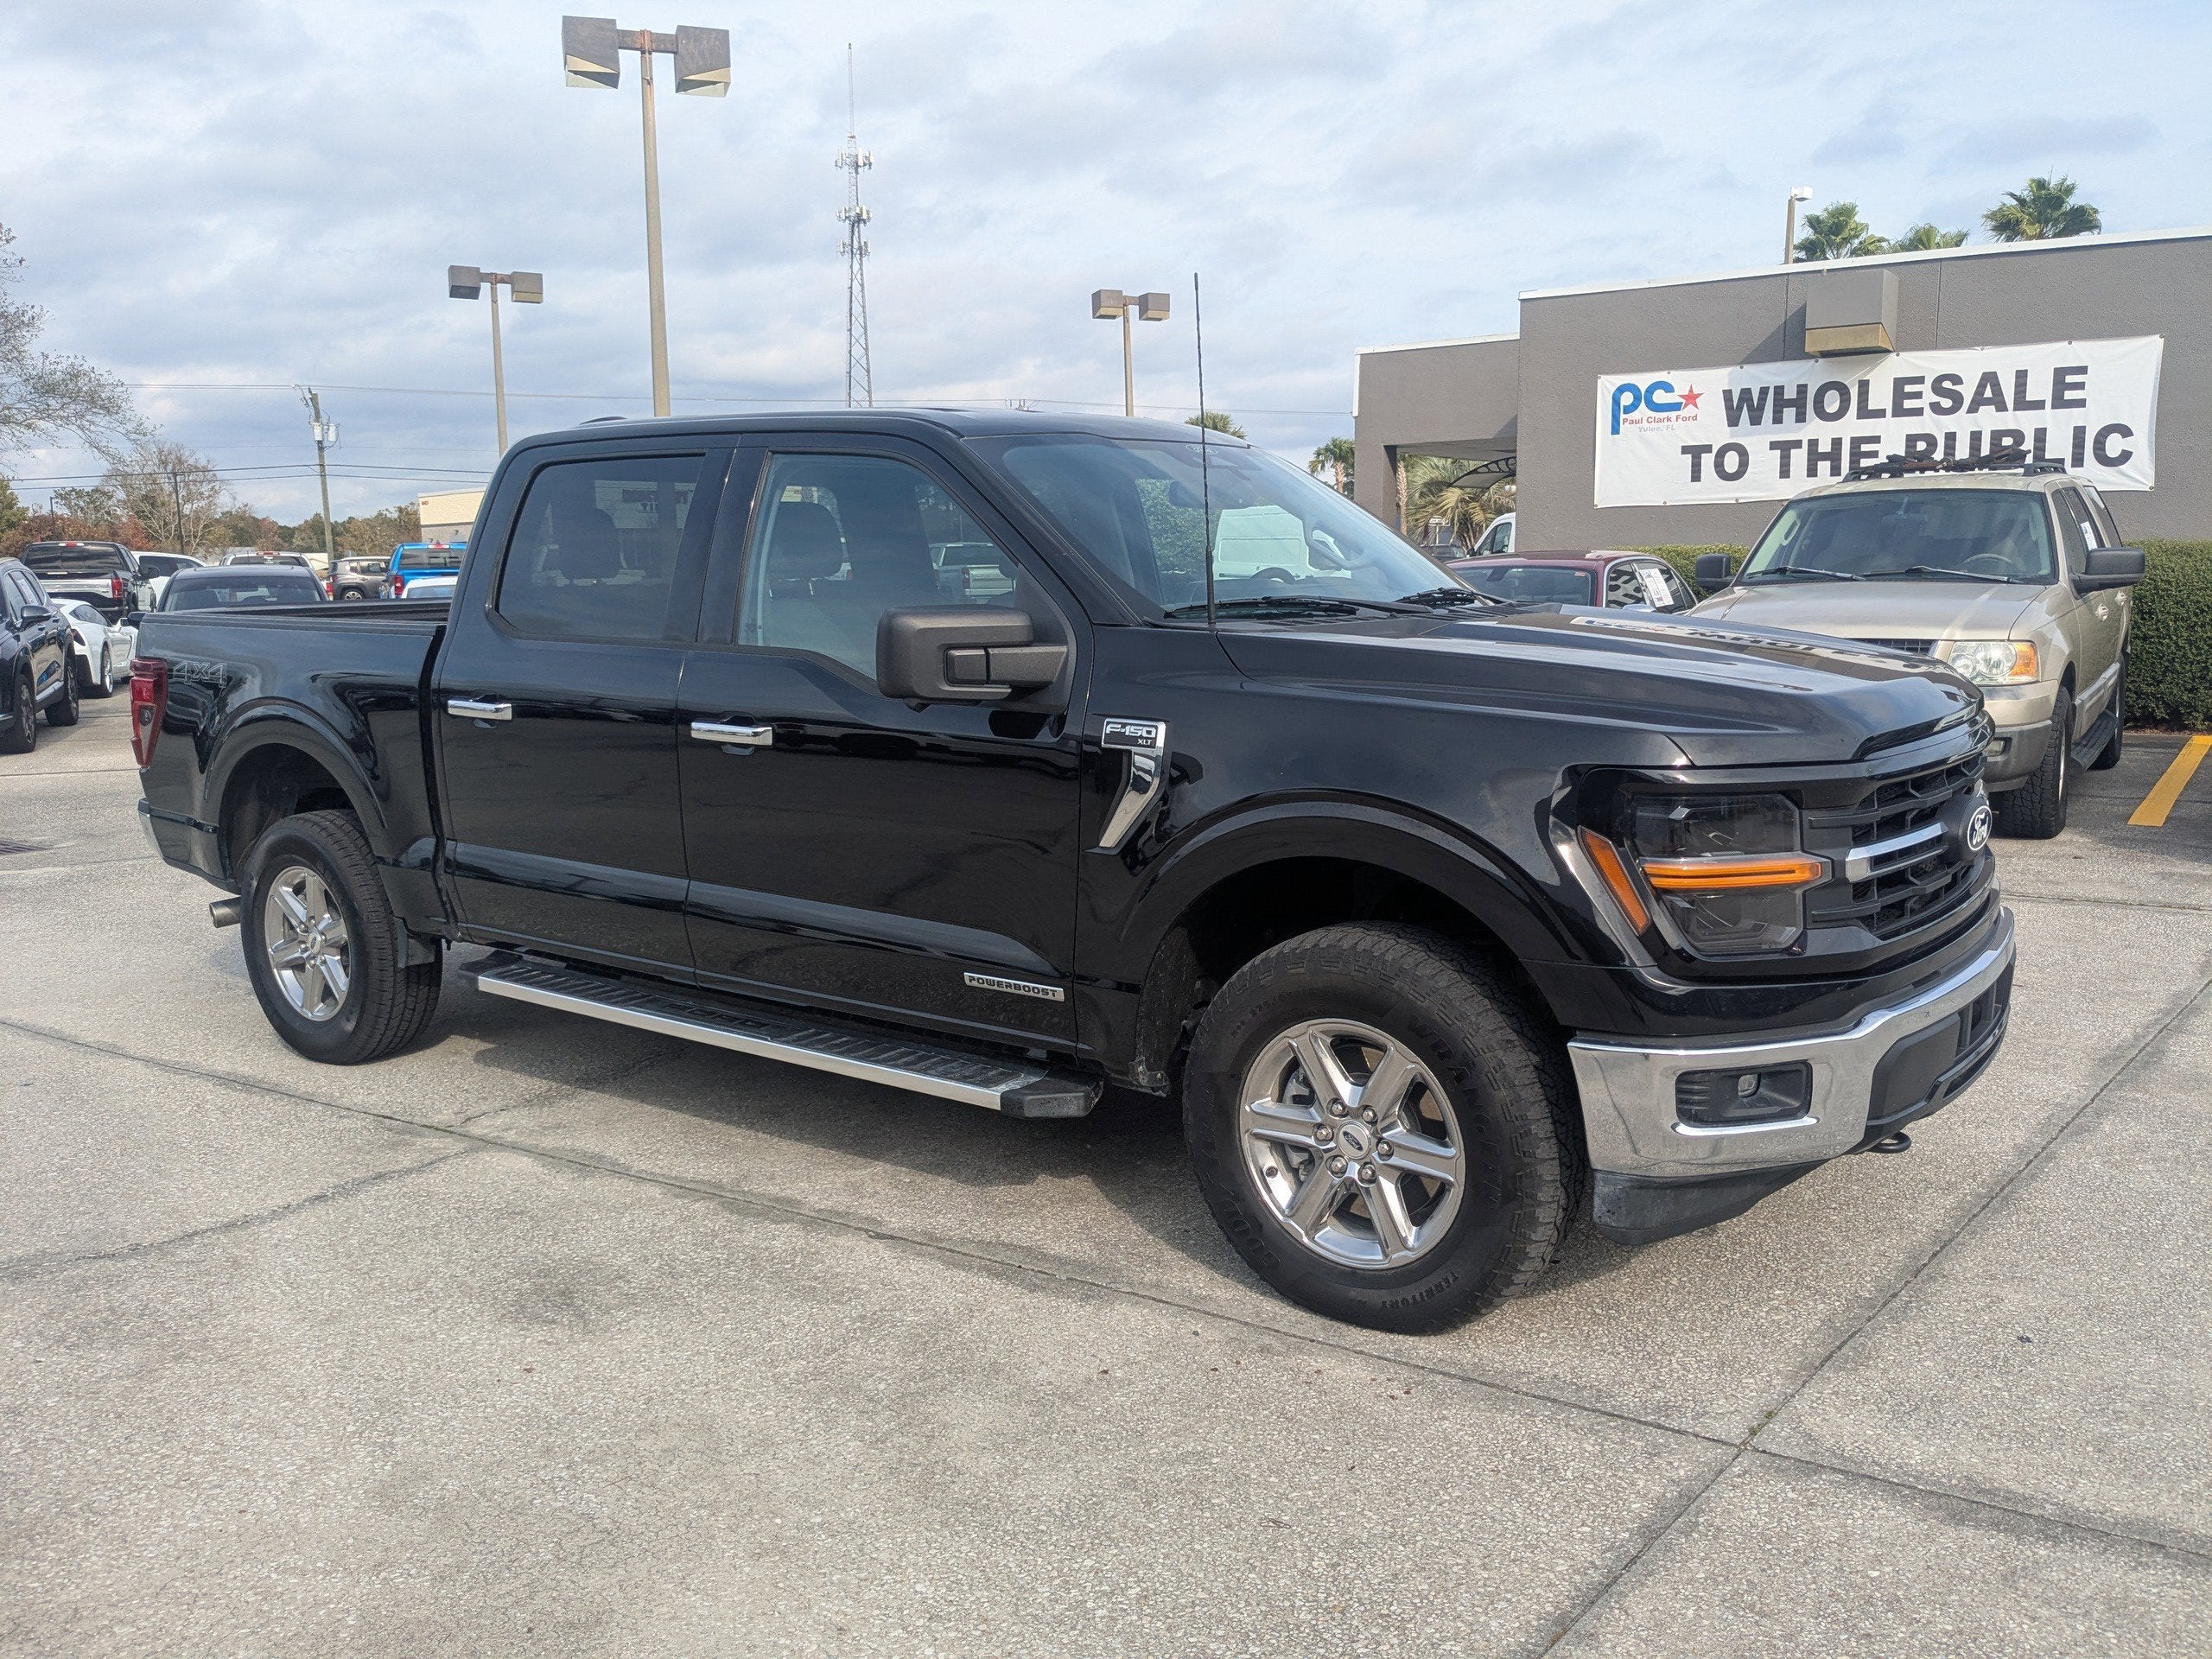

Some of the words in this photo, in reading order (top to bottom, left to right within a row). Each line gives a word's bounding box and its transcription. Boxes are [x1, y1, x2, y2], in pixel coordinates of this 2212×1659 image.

[1722, 365, 2089, 428] WHOLESALE
[1622, 416, 1643, 425] Paul
[1646, 415, 1673, 424] Clark
[1675, 413, 1698, 423] Ford
[1681, 442, 1750, 483] TO
[1769, 435, 1882, 480] THE
[1105, 722, 1157, 738] F-150
[1971, 810, 1991, 847] Ford
[968, 975, 1058, 998] POWERBOOST
